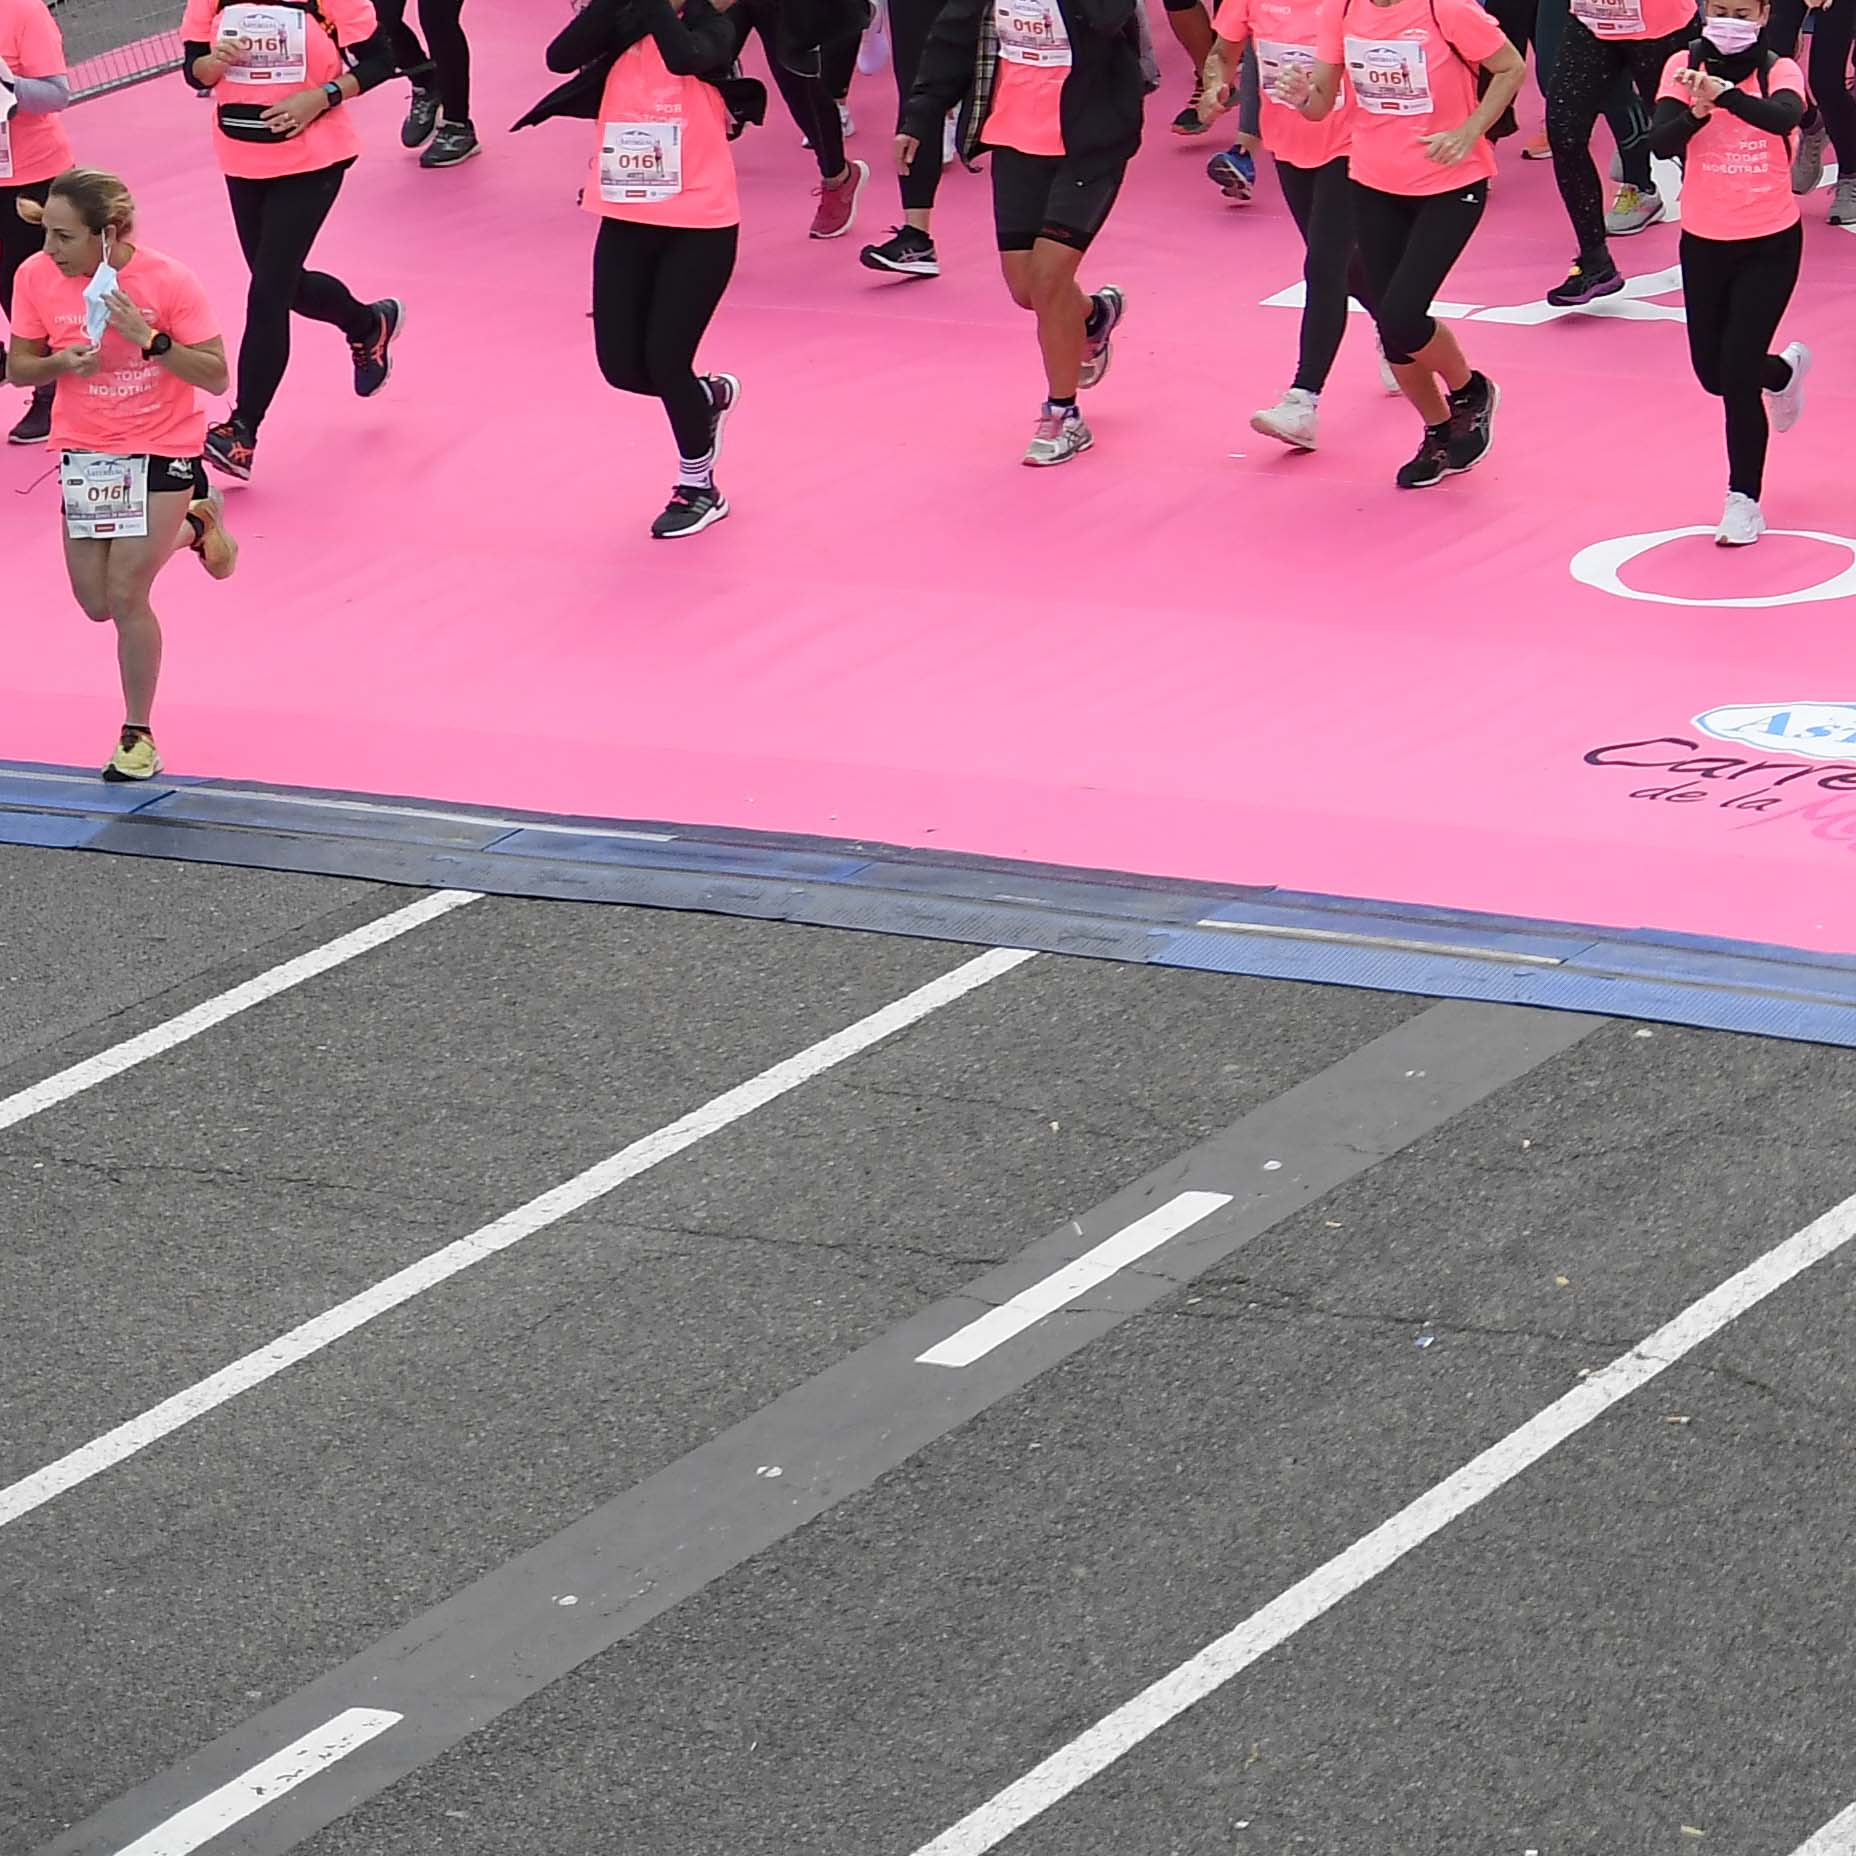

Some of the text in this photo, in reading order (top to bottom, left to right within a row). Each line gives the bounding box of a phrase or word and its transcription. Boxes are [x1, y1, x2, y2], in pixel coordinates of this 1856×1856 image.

[1014, 19, 1043, 34] 016
[1370, 71, 1401, 84] 016
[1736, 139, 1767, 151] POR
[619, 155, 653, 168] 016
[88, 485, 120, 501] 016
[1630, 779, 1708, 807] de
[1720, 786, 1780, 814] la
